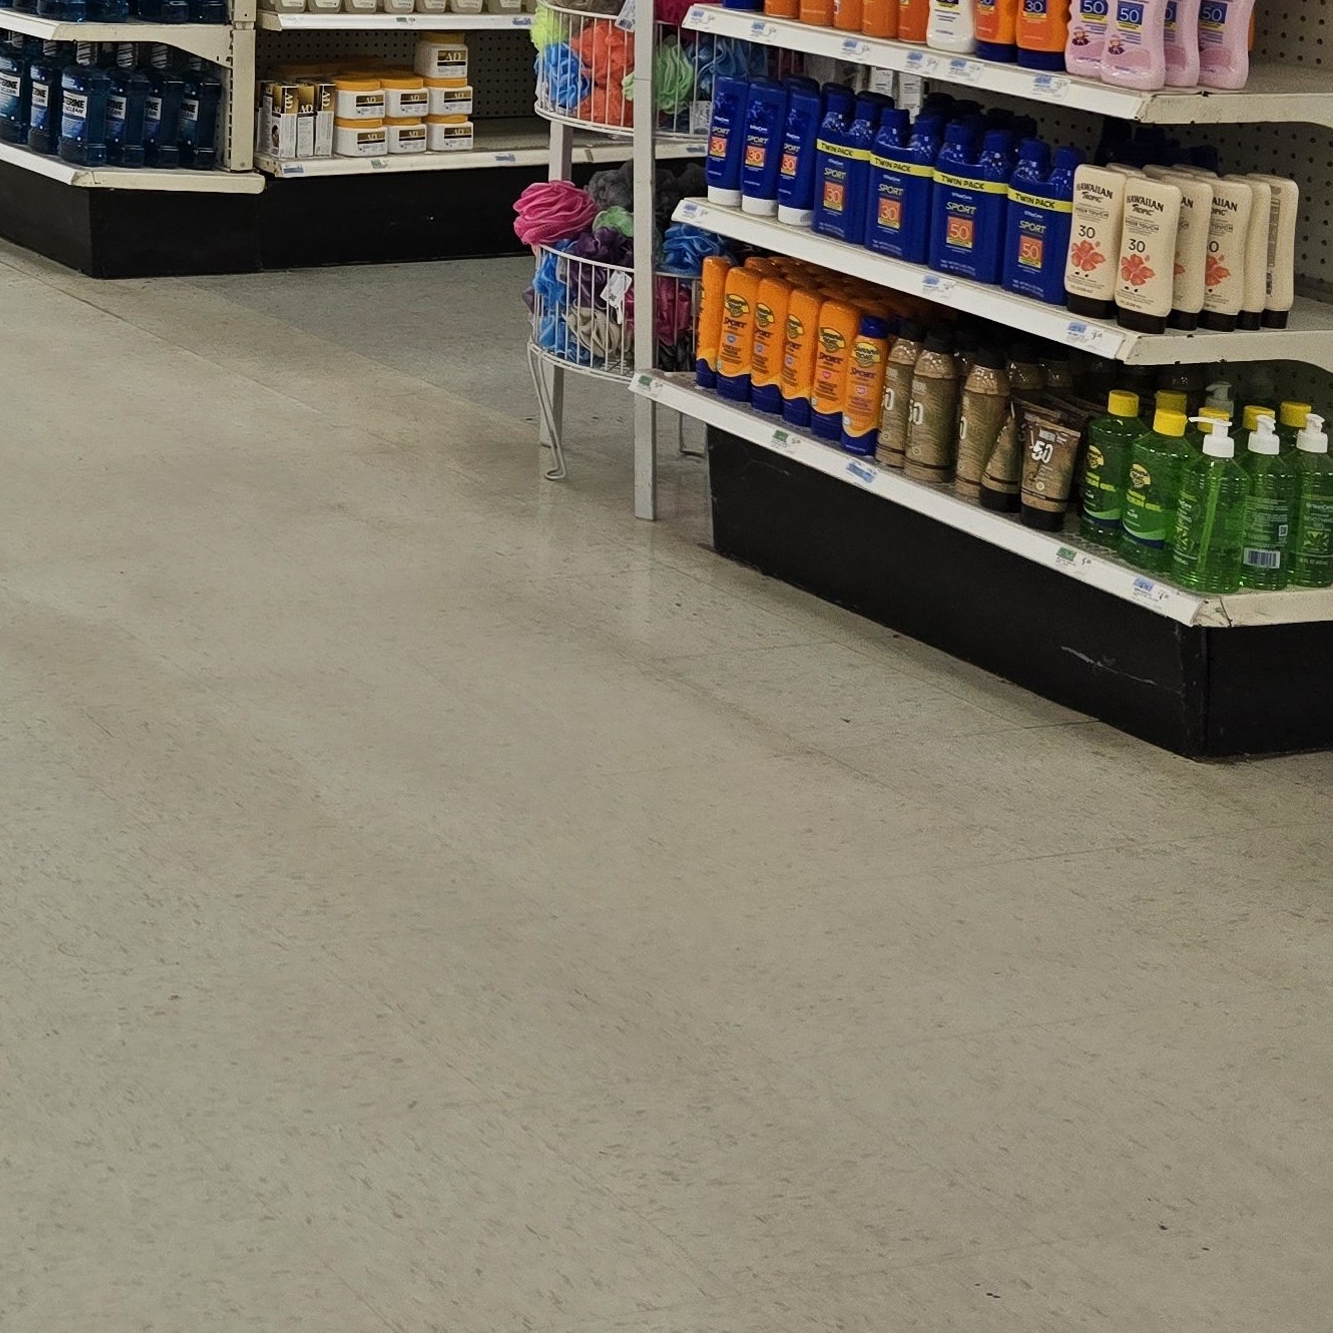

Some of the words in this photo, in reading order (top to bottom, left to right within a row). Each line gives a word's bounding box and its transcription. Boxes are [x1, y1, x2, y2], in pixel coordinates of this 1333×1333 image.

[1024, 0, 1044, 13] 30
[1082, 0, 1105, 15] 50
[1201, 6, 1223, 21] 50
[1119, 7, 1140, 23] 50
[711, 125, 731, 136] SPORT
[710, 141, 726, 153] 30
[746, 134, 769, 145] SPORT
[746, 149, 764, 163] 30
[820, 142, 835, 155] TWIN
[834, 147, 854, 157] PACK
[781, 158, 796, 171] 30
[873, 155, 891, 169] TWIN
[890, 161, 912, 173] PACK
[823, 166, 847, 180] SPORT
[877, 183, 904, 197] SPORT
[940, 174, 960, 187] TWIN
[961, 179, 986, 191] PACK
[824, 187, 843, 203] 30
[1076, 182, 1114, 200] HAWAIIAN
[945, 201, 977, 215] SPORT
[1014, 192, 1035, 205] TWIN
[1034, 196, 1056, 211] PACK
[1126, 194, 1165, 213] HAWAIIAN
[880, 205, 899, 221] 30
[950, 223, 971, 240] 50
[1018, 219, 1048, 234] SPORT
[1077, 224, 1097, 239] 30
[1138, 221, 1160, 232] TOUCH
[1020, 242, 1041, 259] 50
[1127, 238, 1147, 253] 30
[722, 316, 747, 329] SPORT
[817, 352, 845, 364] SPORT
[849, 368, 878, 379] SPORT
[1031, 440, 1055, 464] 50
